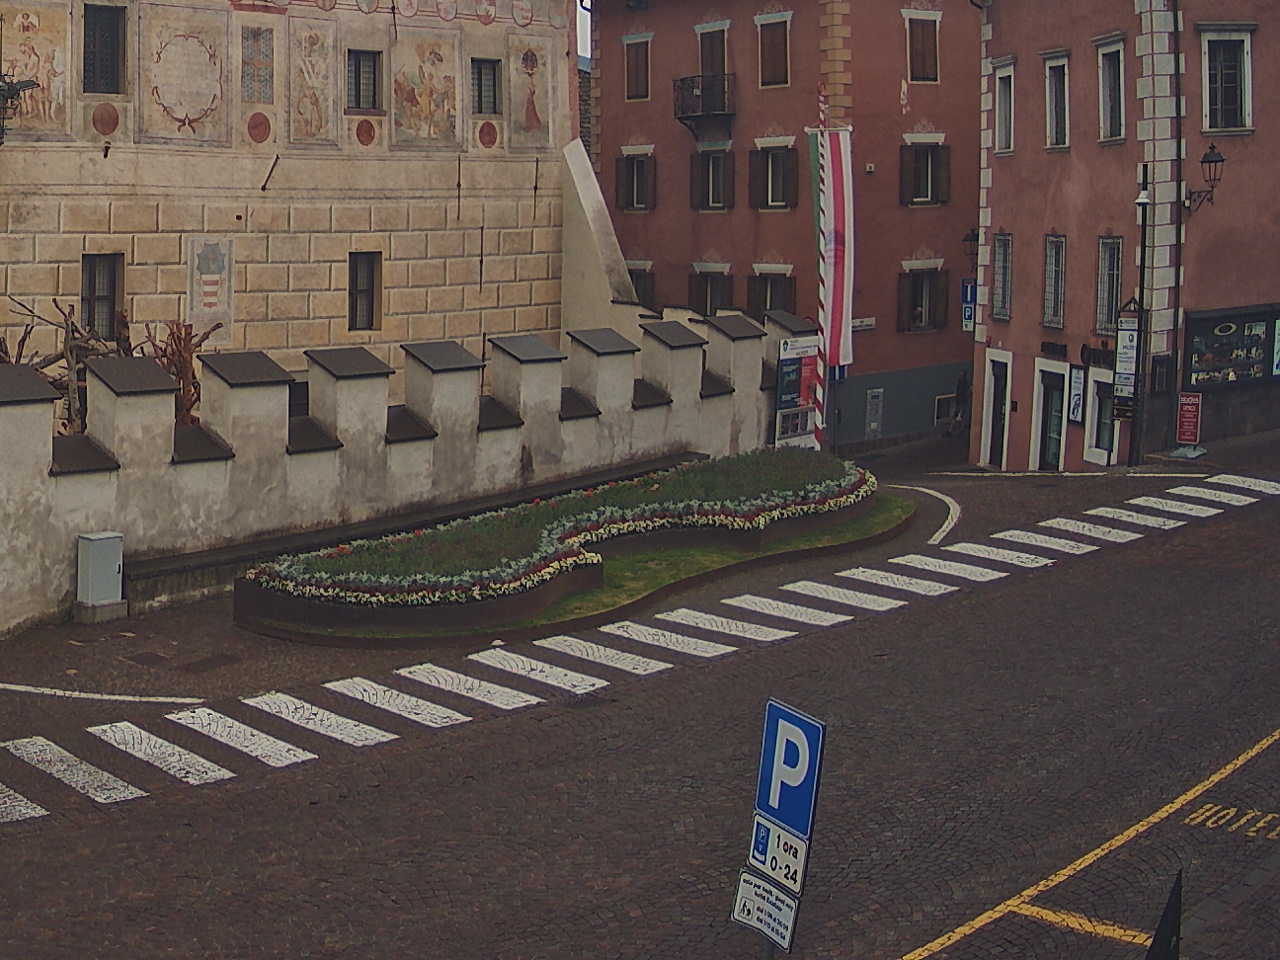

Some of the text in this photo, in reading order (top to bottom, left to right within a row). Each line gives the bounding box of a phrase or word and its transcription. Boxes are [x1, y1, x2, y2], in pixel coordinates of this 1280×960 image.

[769, 719, 809, 809] P
[776, 833, 798, 859] 1 ora
